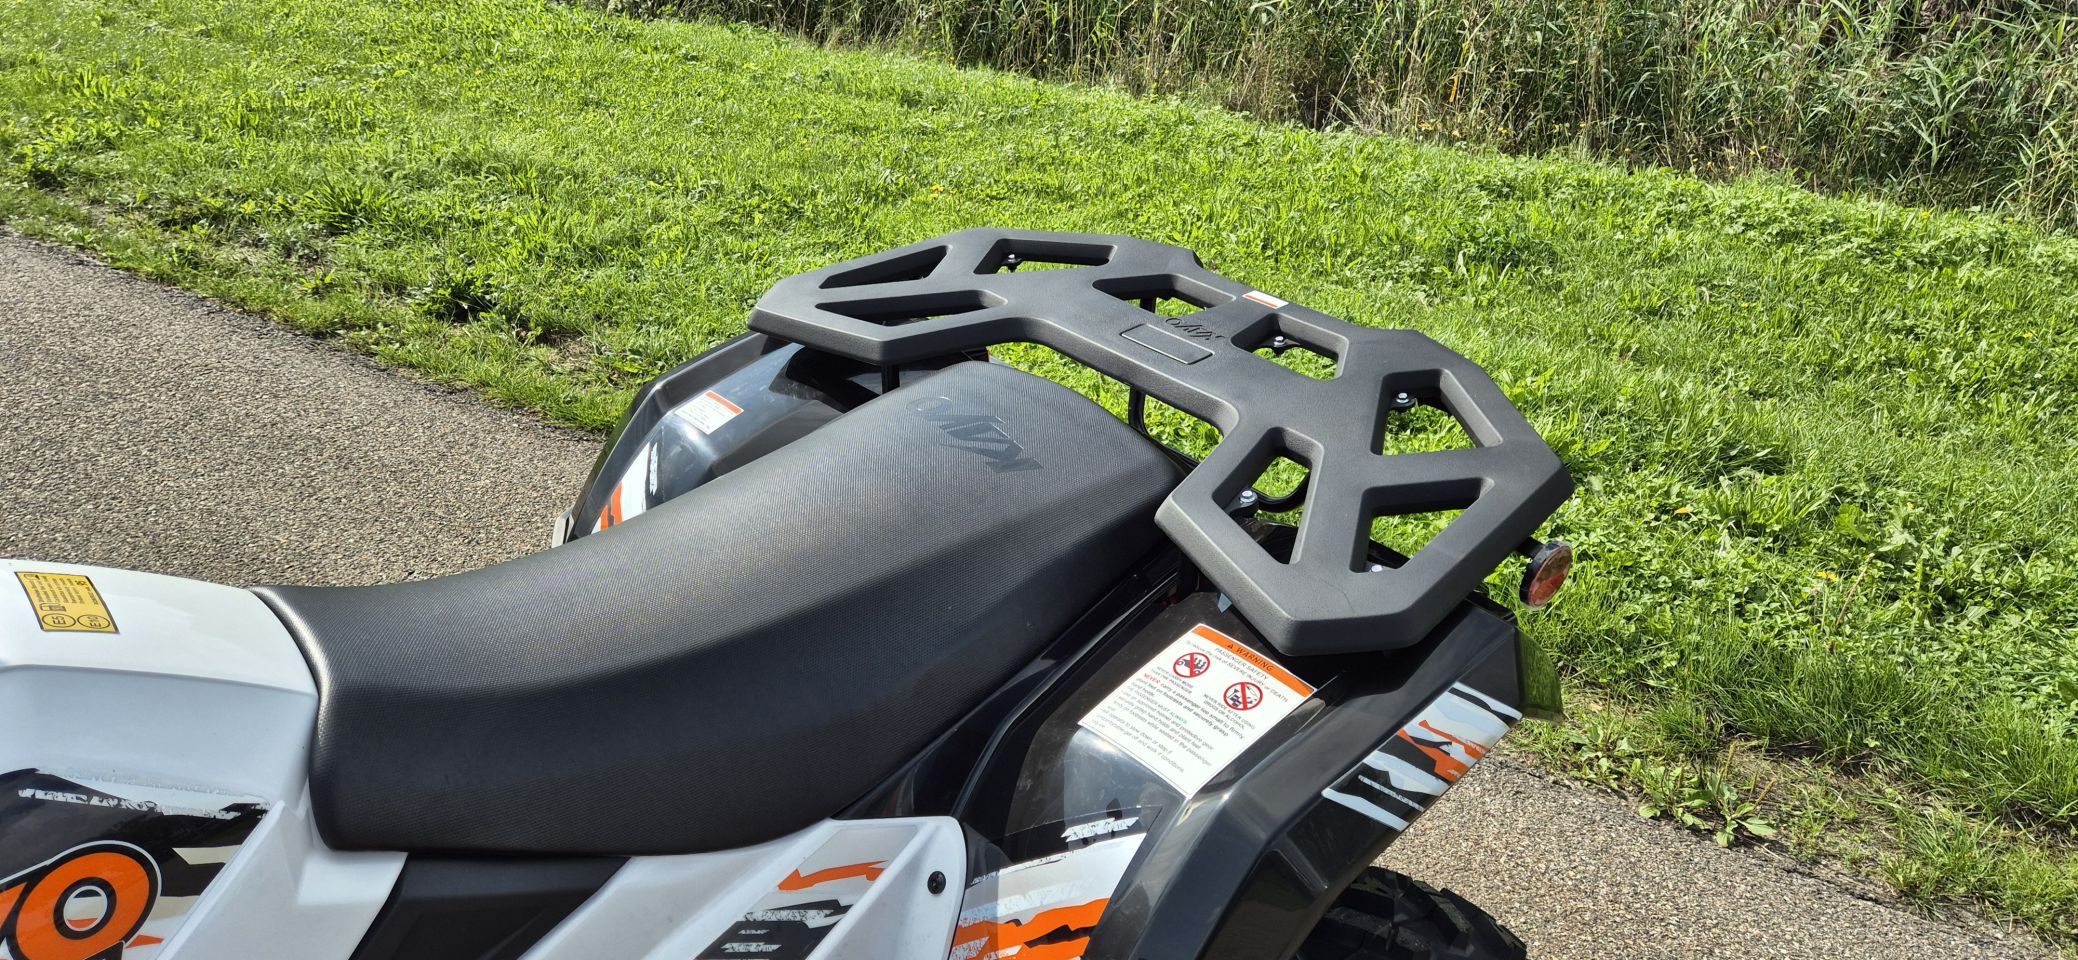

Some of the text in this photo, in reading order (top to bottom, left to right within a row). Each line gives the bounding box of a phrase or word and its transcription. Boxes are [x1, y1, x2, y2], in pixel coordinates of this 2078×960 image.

[51, 615, 66, 625] E5
[1214, 648, 1268, 679] PASSENGER SAFETY
[1234, 647, 1274, 670] WARNING
[1226, 662, 1246, 675] SEVERE
[1245, 674, 1264, 686] INJURY
[1269, 689, 1289, 701] DEATH
[1159, 683, 1172, 691] carry
[1174, 692, 1201, 709] passenger
[1208, 713, 1224, 723] small
[1227, 727, 1245, 738] firmly
[1162, 692, 1183, 706] footrests
[1191, 711, 1214, 726] securely
[1211, 725, 1229, 736] grasp
[0, 841, 162, 960] 0
